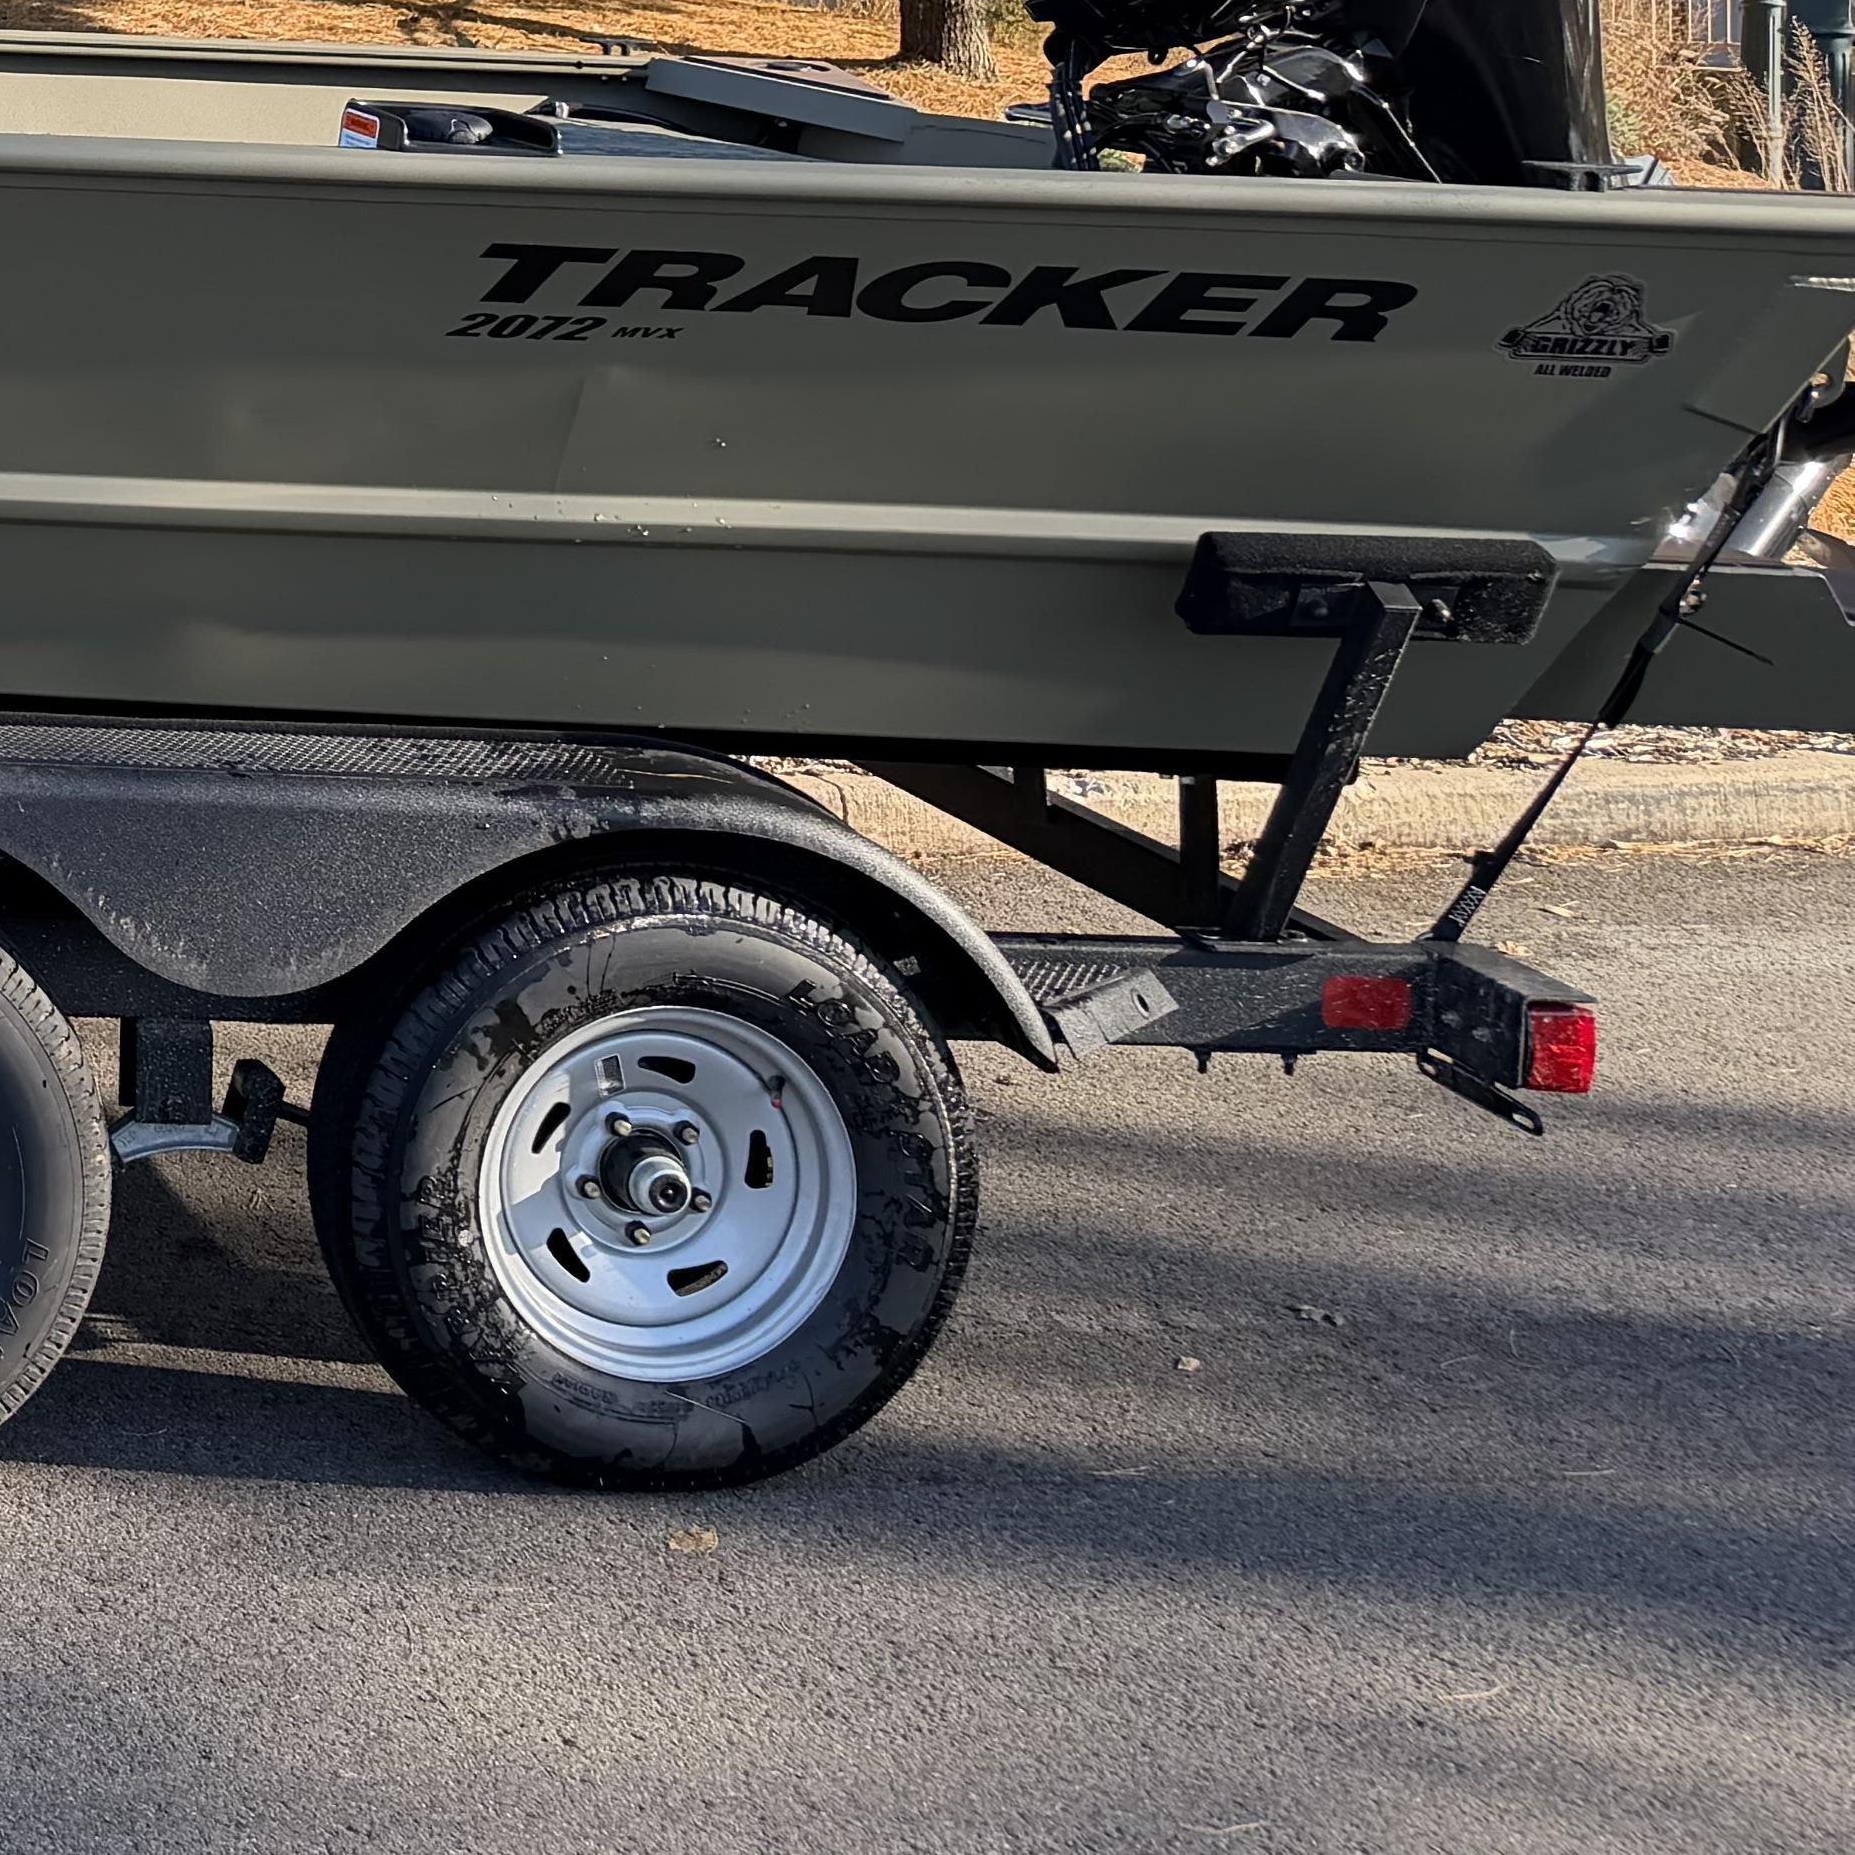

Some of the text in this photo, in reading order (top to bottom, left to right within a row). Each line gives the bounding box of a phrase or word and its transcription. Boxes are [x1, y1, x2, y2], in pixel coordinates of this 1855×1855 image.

[479, 242, 1418, 343] TRACKER
[444, 312, 686, 341] 2072 MVX
[1531, 335, 1637, 356] GRIZZLY
[1534, 364, 1612, 378] ALL WELDED
